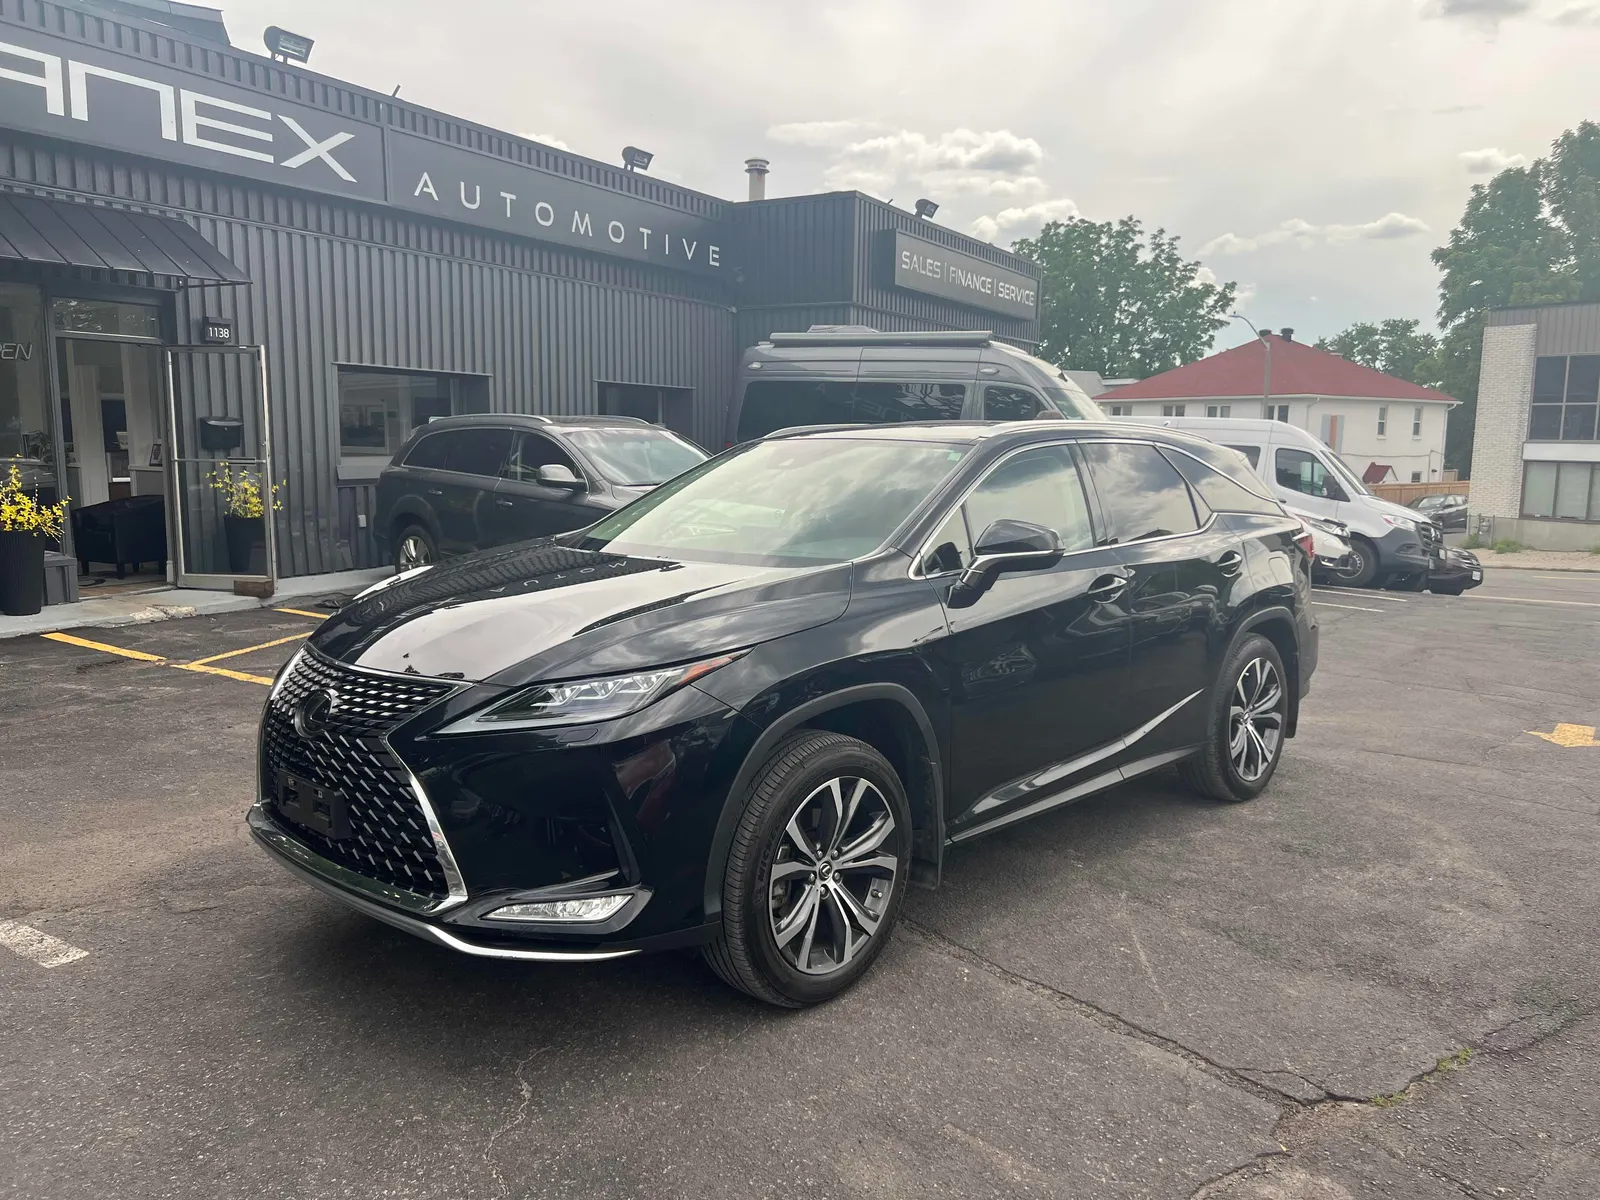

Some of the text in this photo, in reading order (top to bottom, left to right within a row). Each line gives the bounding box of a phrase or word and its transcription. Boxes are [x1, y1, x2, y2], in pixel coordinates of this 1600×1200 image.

[413, 171, 721, 268] AUTOMOTIVE
[901, 250, 1036, 307] SALES FINANCE SERVICE
[0, 342, 33, 360] EN
[208, 326, 230, 339] 1138
